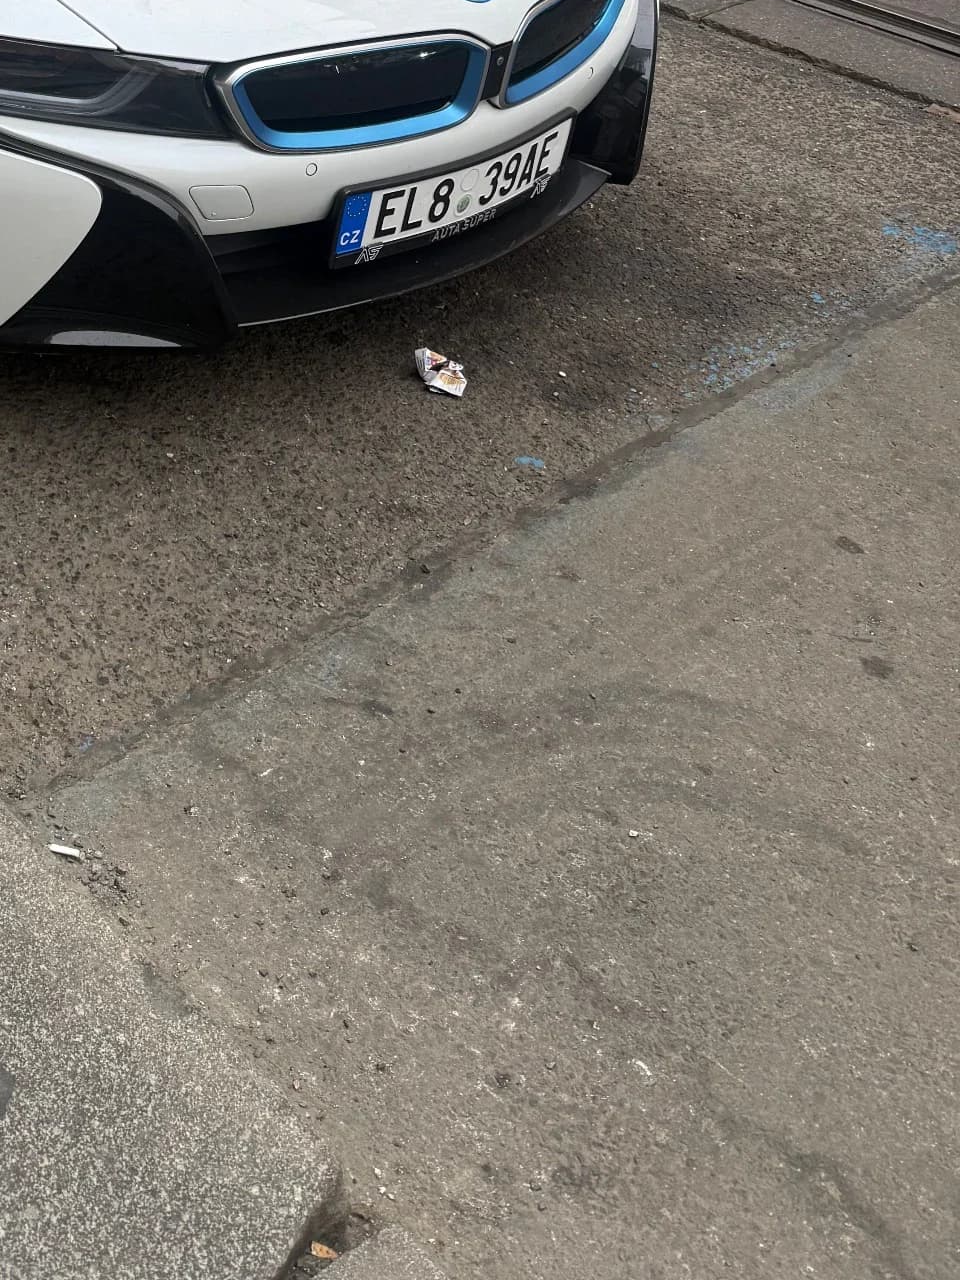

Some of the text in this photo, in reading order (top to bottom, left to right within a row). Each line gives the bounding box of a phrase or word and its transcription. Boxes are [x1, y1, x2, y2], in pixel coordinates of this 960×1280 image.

[340, 131, 559, 247] CZ EL8 39AE
[431, 224, 461, 242] AUTA
[461, 209, 497, 232] SUPER
